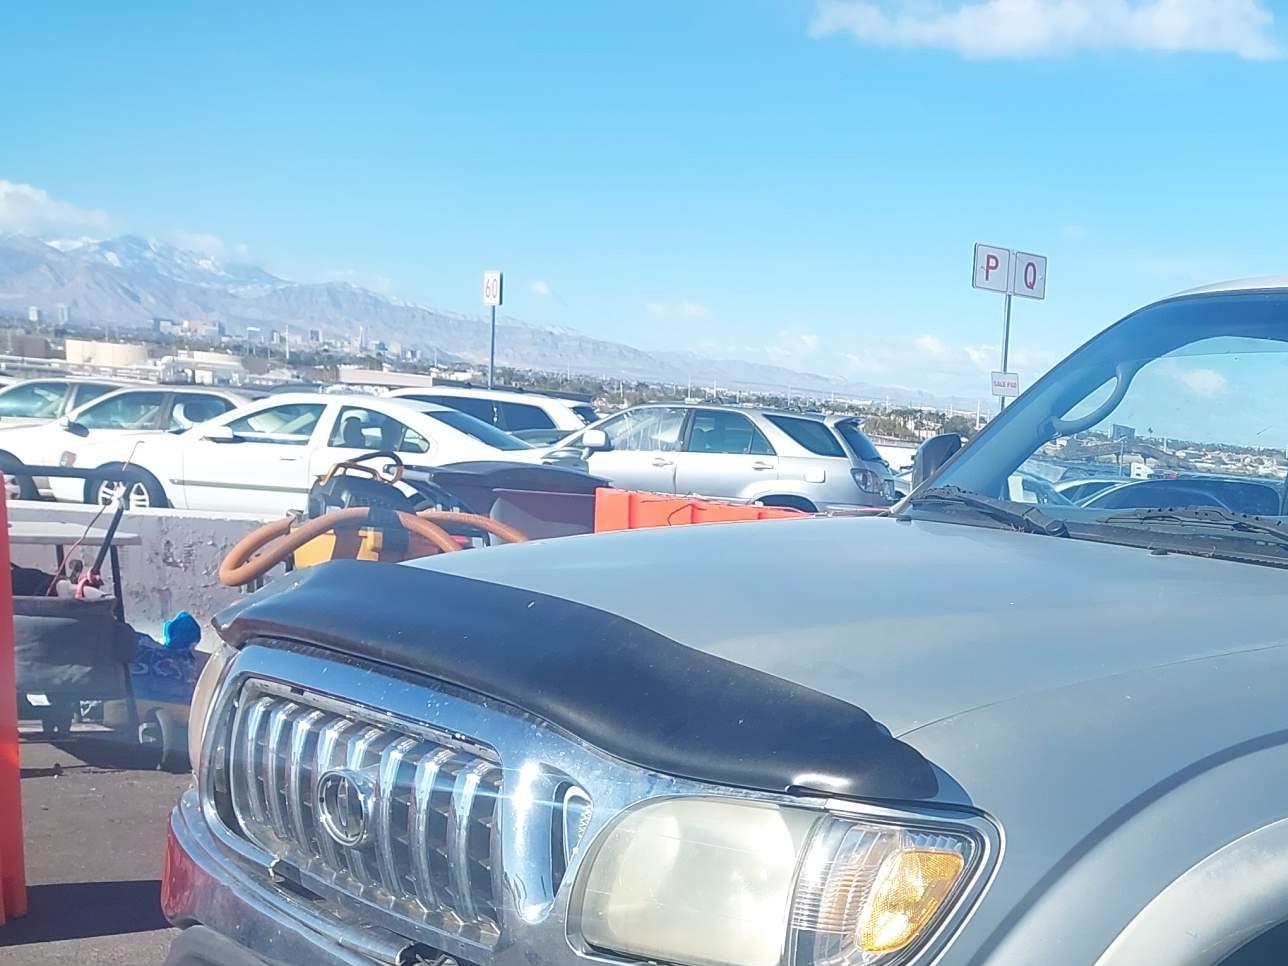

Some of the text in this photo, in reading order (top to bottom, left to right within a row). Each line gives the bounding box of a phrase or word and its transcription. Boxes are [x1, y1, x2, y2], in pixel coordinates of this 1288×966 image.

[985, 254, 999, 281] P
[1024, 262, 1037, 290] Q
[486, 279, 498, 298] 60
